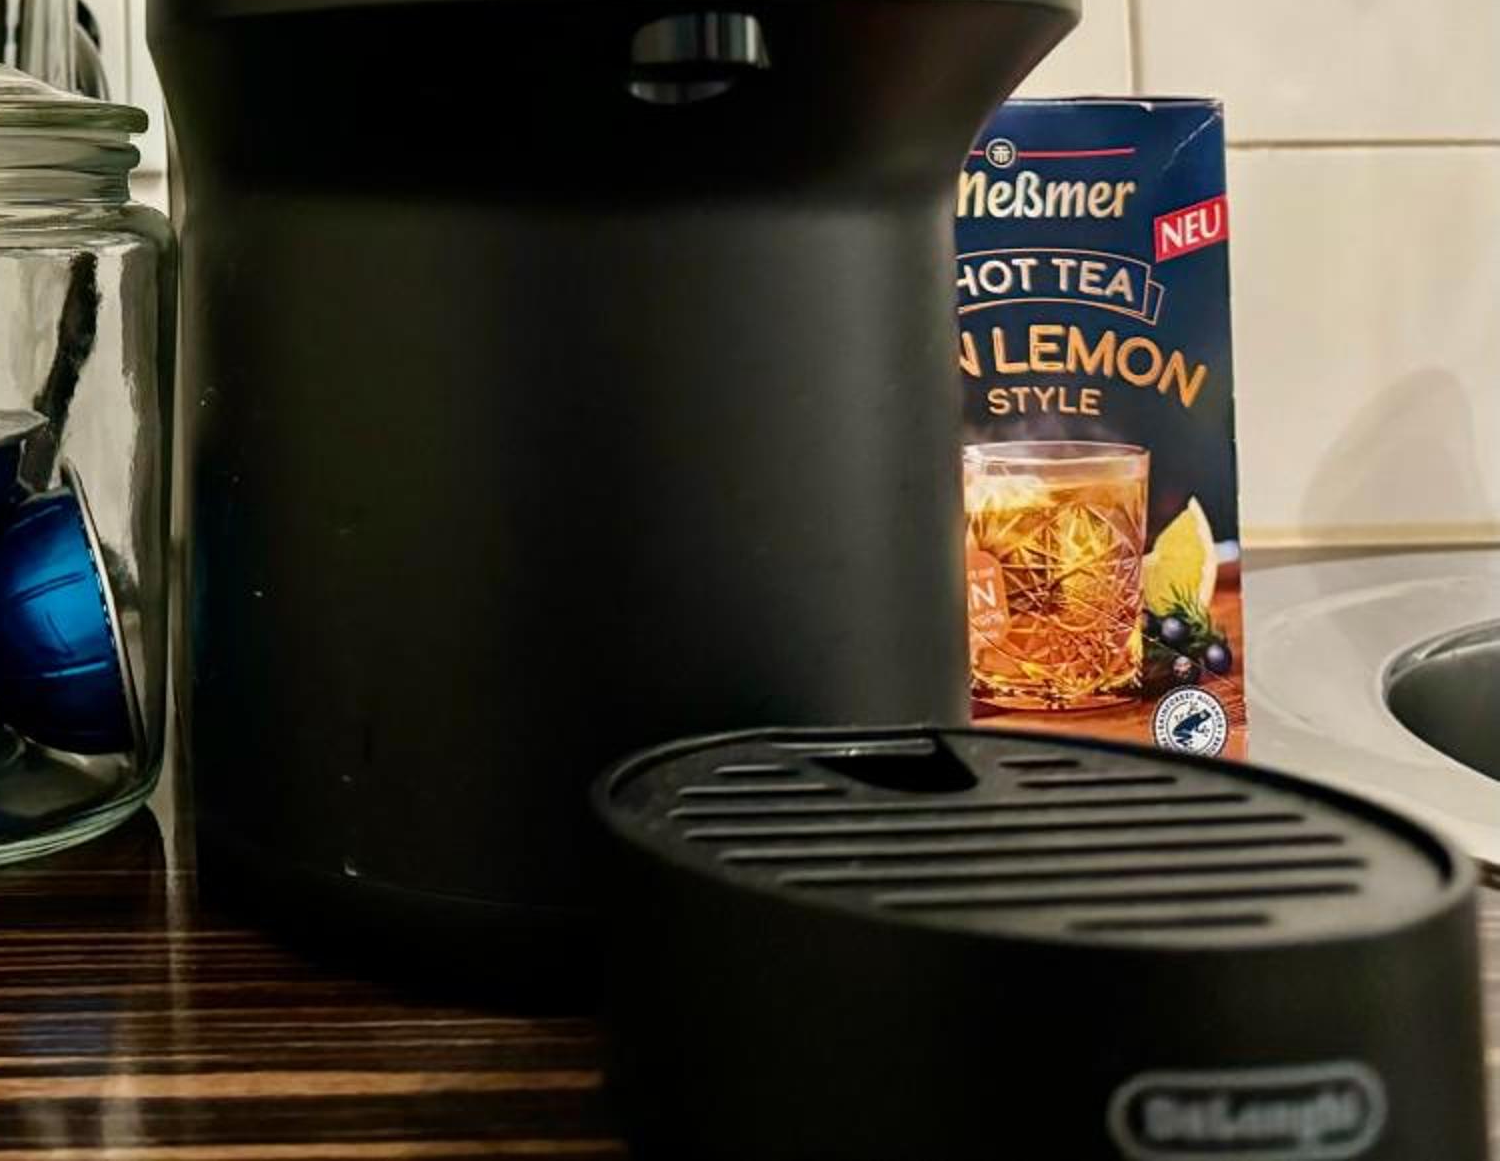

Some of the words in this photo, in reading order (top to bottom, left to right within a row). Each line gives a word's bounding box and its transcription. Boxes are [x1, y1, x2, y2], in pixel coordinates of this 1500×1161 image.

[1160, 204, 1222, 254] NEU
[1051, 258, 1135, 303] TEA
[991, 324, 1208, 408] LEMON
[987, 386, 1103, 416] STYLE
